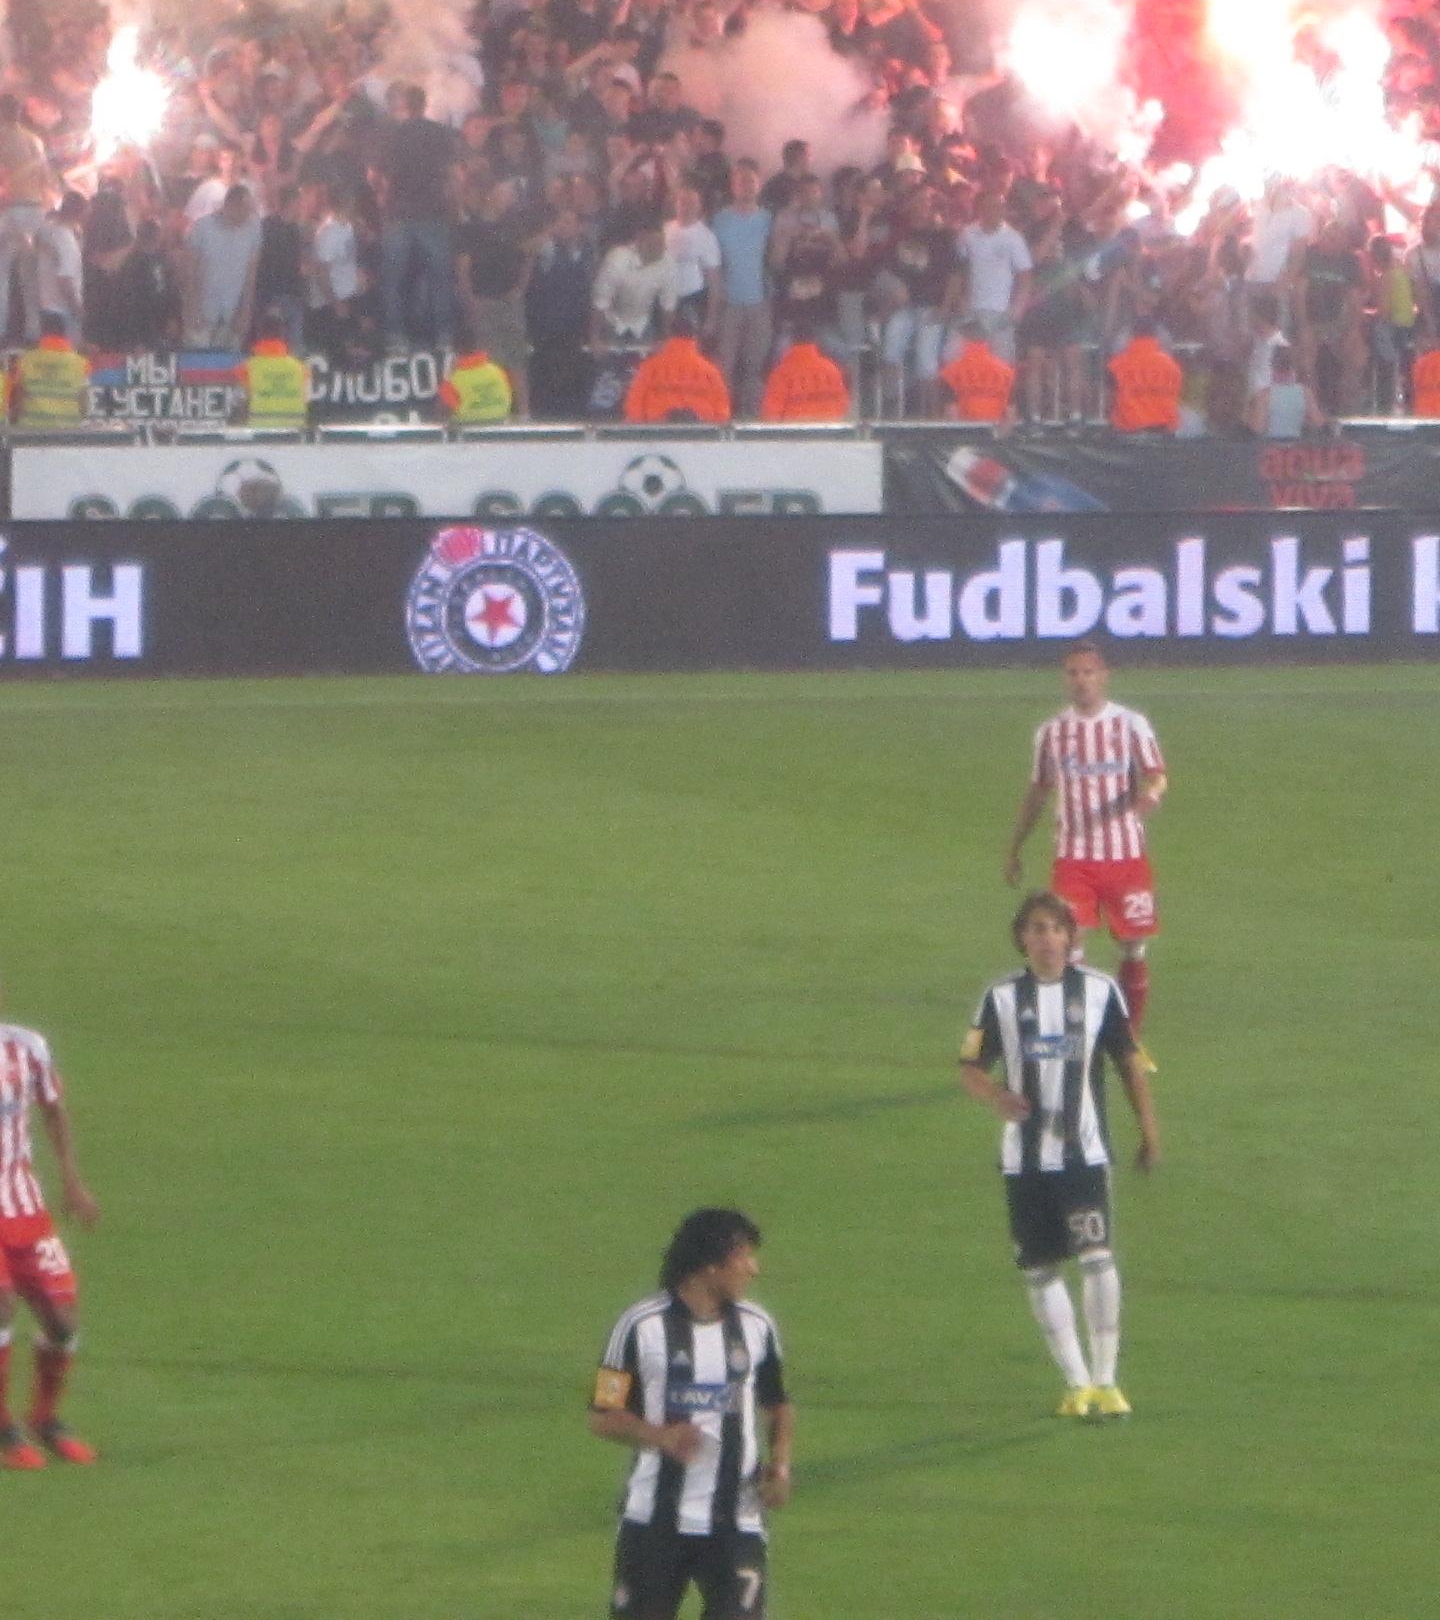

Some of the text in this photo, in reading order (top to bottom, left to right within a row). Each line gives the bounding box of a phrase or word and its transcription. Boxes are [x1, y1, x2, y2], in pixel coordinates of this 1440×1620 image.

[126, 353, 177, 386] МЫ
[827, 536, 1371, 642] Fudbalski
[735, 1566, 762, 1613] 7
